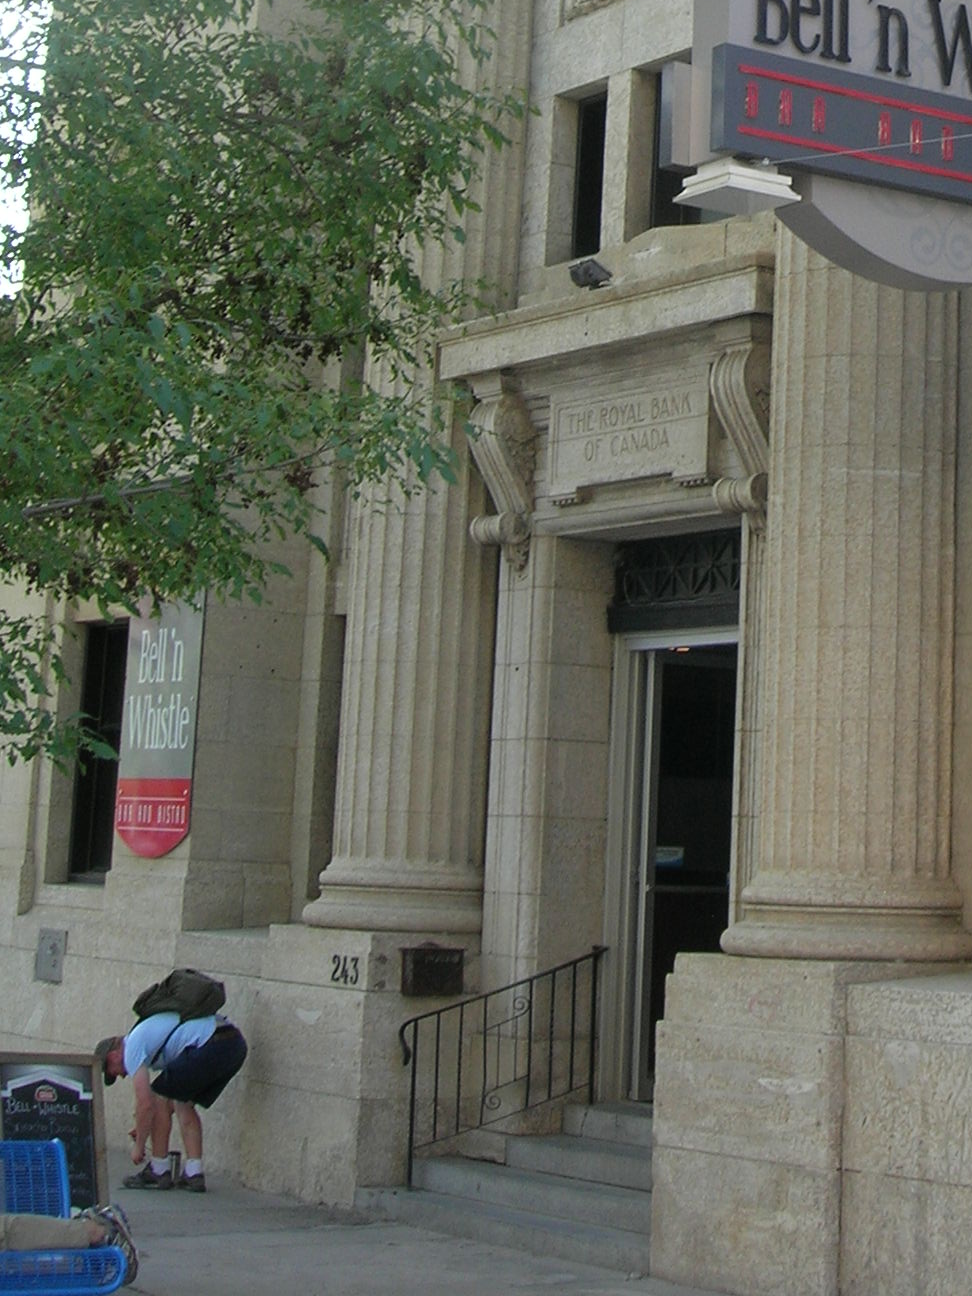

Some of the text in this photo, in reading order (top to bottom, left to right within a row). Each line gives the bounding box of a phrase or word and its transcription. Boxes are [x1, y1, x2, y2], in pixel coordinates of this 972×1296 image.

[744, 80, 826, 135] BAR
[877, 111, 954, 162] AND
[567, 391, 692, 435] THE ROYAL BANK
[584, 427, 670, 462] OF CANADA
[138, 627, 168, 684] Bell
[129, 693, 190, 749] Whistle
[331, 954, 359, 985] 243
